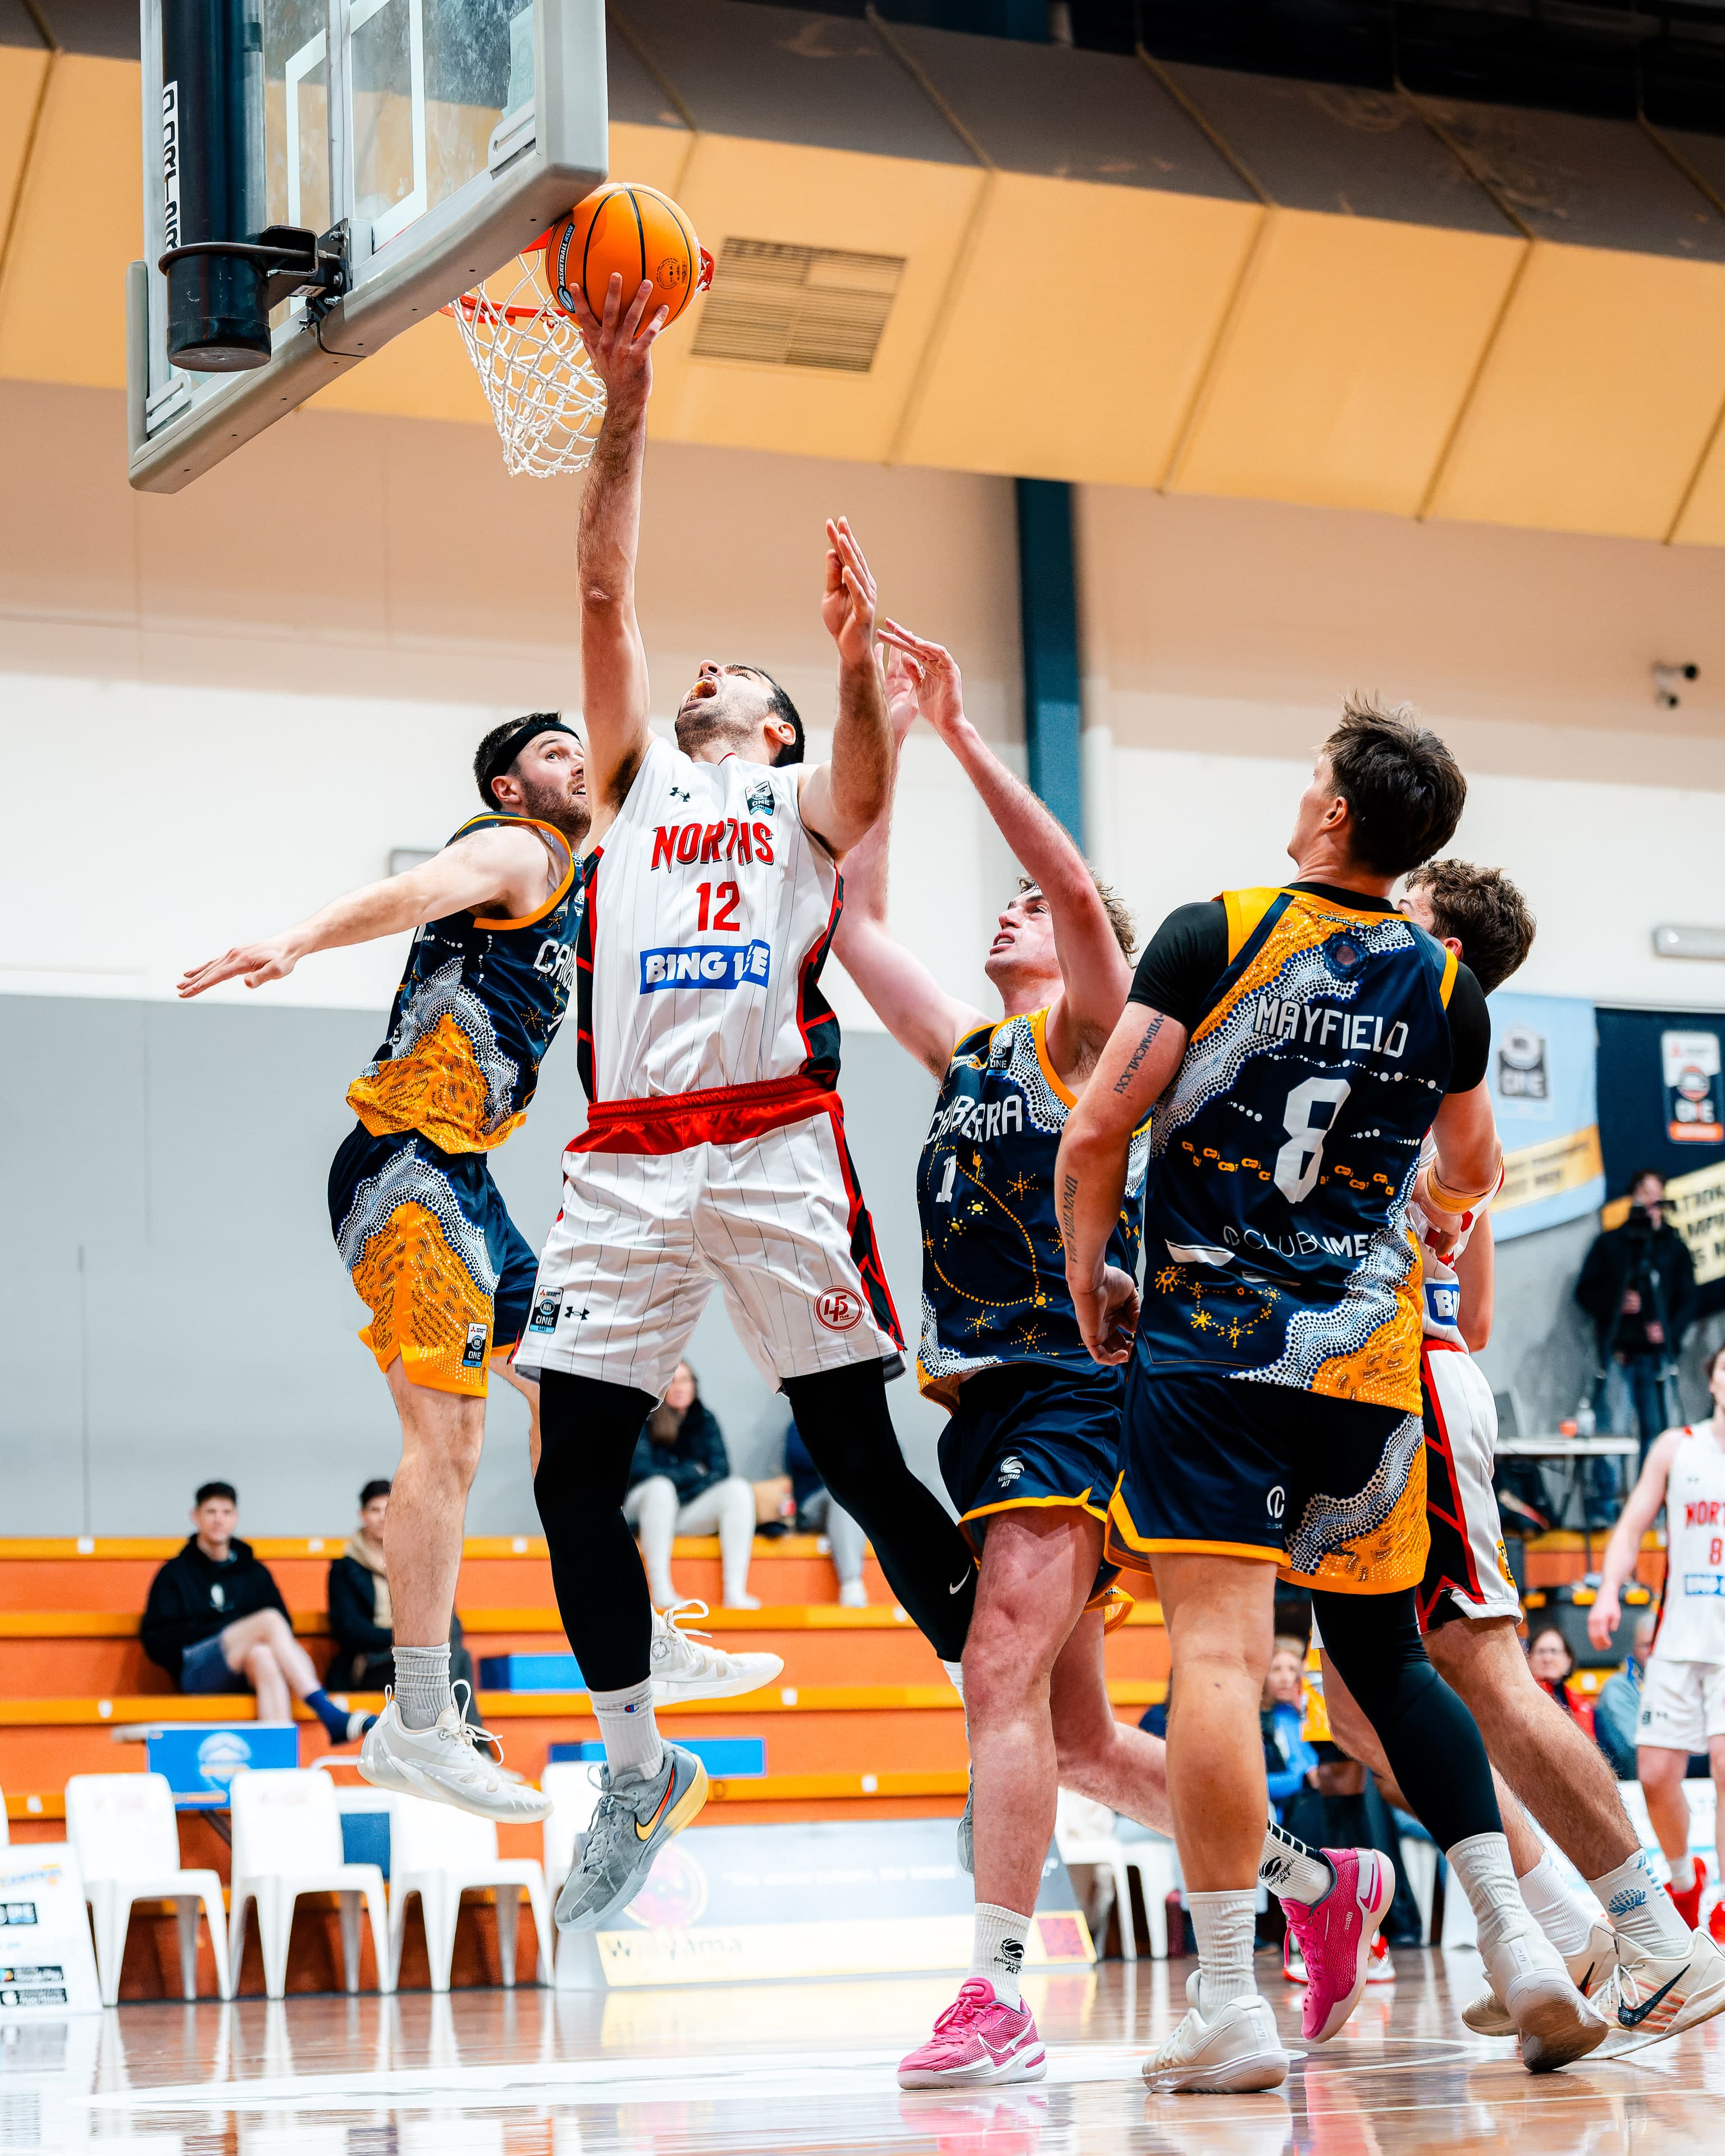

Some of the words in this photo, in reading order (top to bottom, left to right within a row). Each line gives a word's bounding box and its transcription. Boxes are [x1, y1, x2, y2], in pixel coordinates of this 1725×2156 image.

[559, 243, 568, 287] BASKETBALL
[564, 225, 573, 243] NSW
[696, 880, 740, 931] 12
[646, 952, 727, 984] BING
[1254, 994, 1409, 1058] MAYFIELD
[924, 1095, 1023, 1145] CABERRA
[1273, 1076, 1352, 1204] 8
[536, 1315, 554, 1326] ONE
[1434, 1290, 1460, 1319] BI
[468, 1351, 482, 1360] ONE
